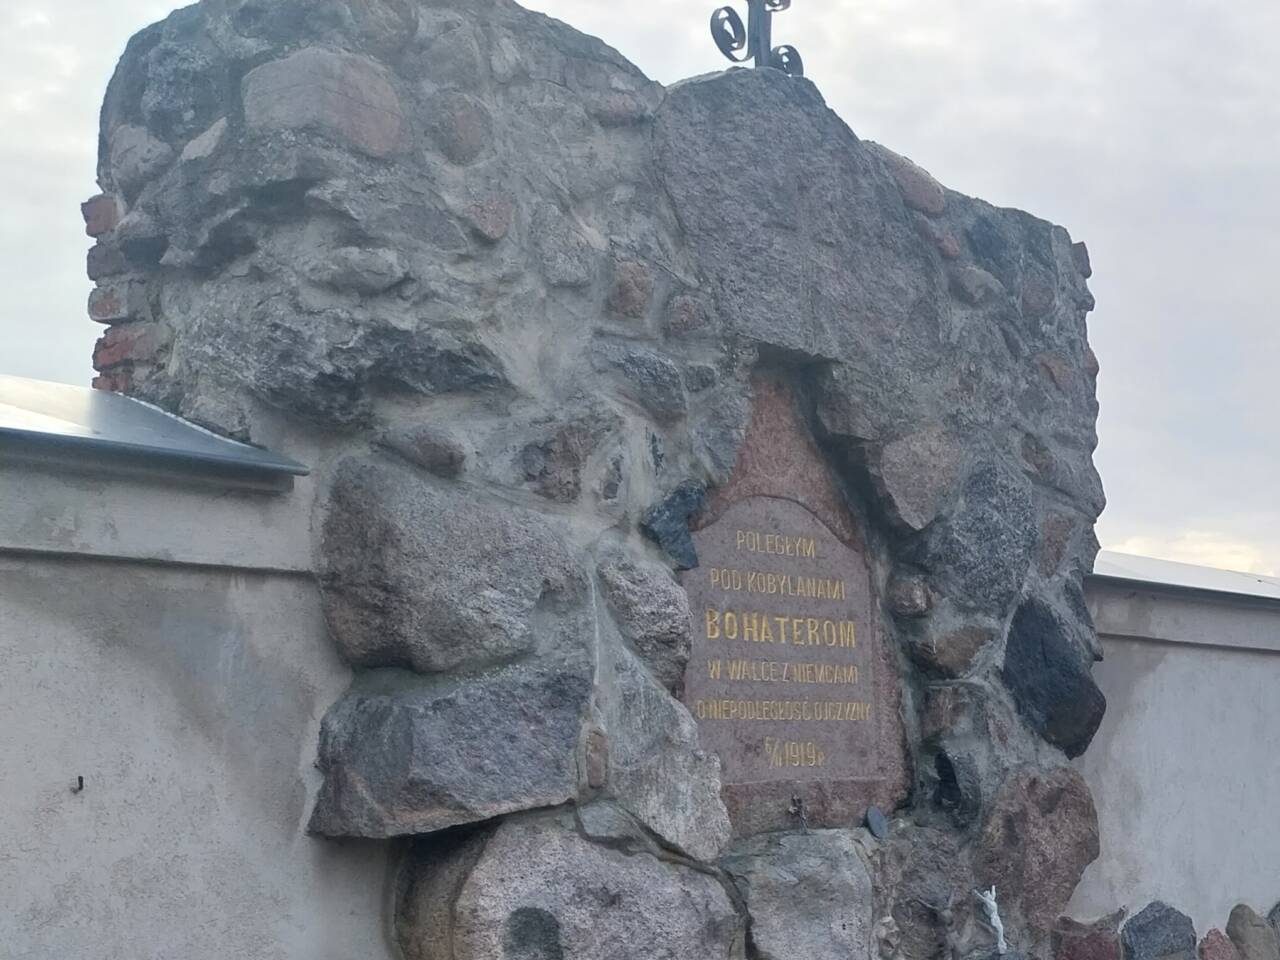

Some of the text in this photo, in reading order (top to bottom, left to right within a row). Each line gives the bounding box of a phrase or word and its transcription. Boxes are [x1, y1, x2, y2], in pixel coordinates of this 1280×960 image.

[736, 530, 817, 559] POLEGŁYM
[710, 568, 846, 600] POD KOBYLANAMI
[705, 608, 857, 649] BOHATEROM
[708, 660, 859, 685] W WALCE Z NIEMCAMI
[697, 700, 706, 720] O
[814, 701, 872, 721] OJCZYZNY
[784, 741, 816, 767] 1919
